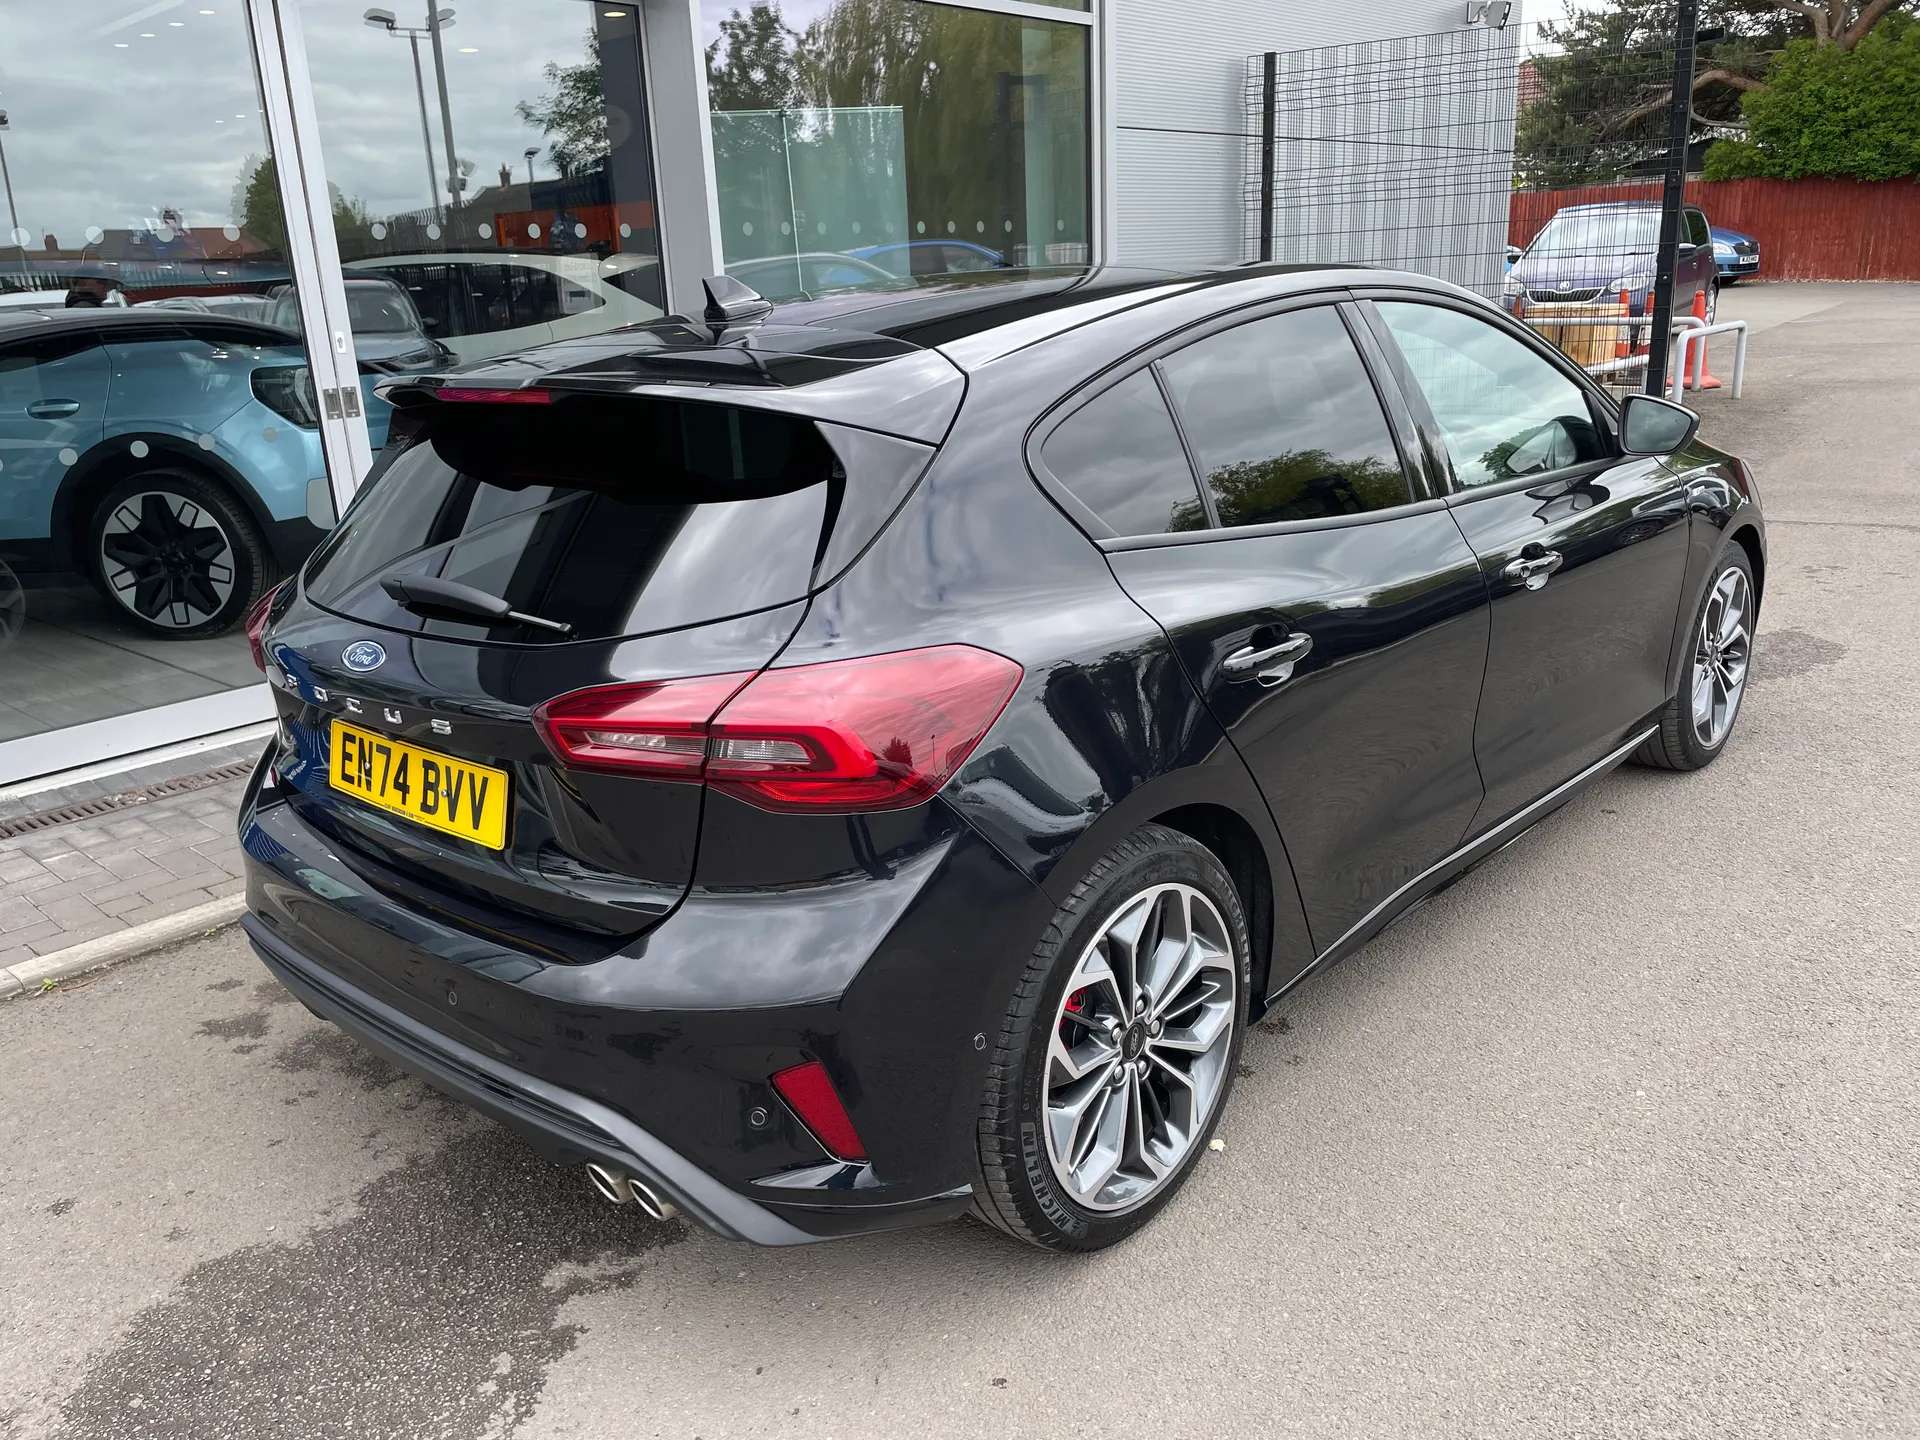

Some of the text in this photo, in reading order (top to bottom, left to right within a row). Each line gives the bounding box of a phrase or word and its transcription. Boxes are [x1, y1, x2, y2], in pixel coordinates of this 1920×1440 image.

[350, 646, 376, 665] Ford
[340, 731, 489, 831] EN74 BVV
[1022, 1131, 1071, 1233] MICHELIN
